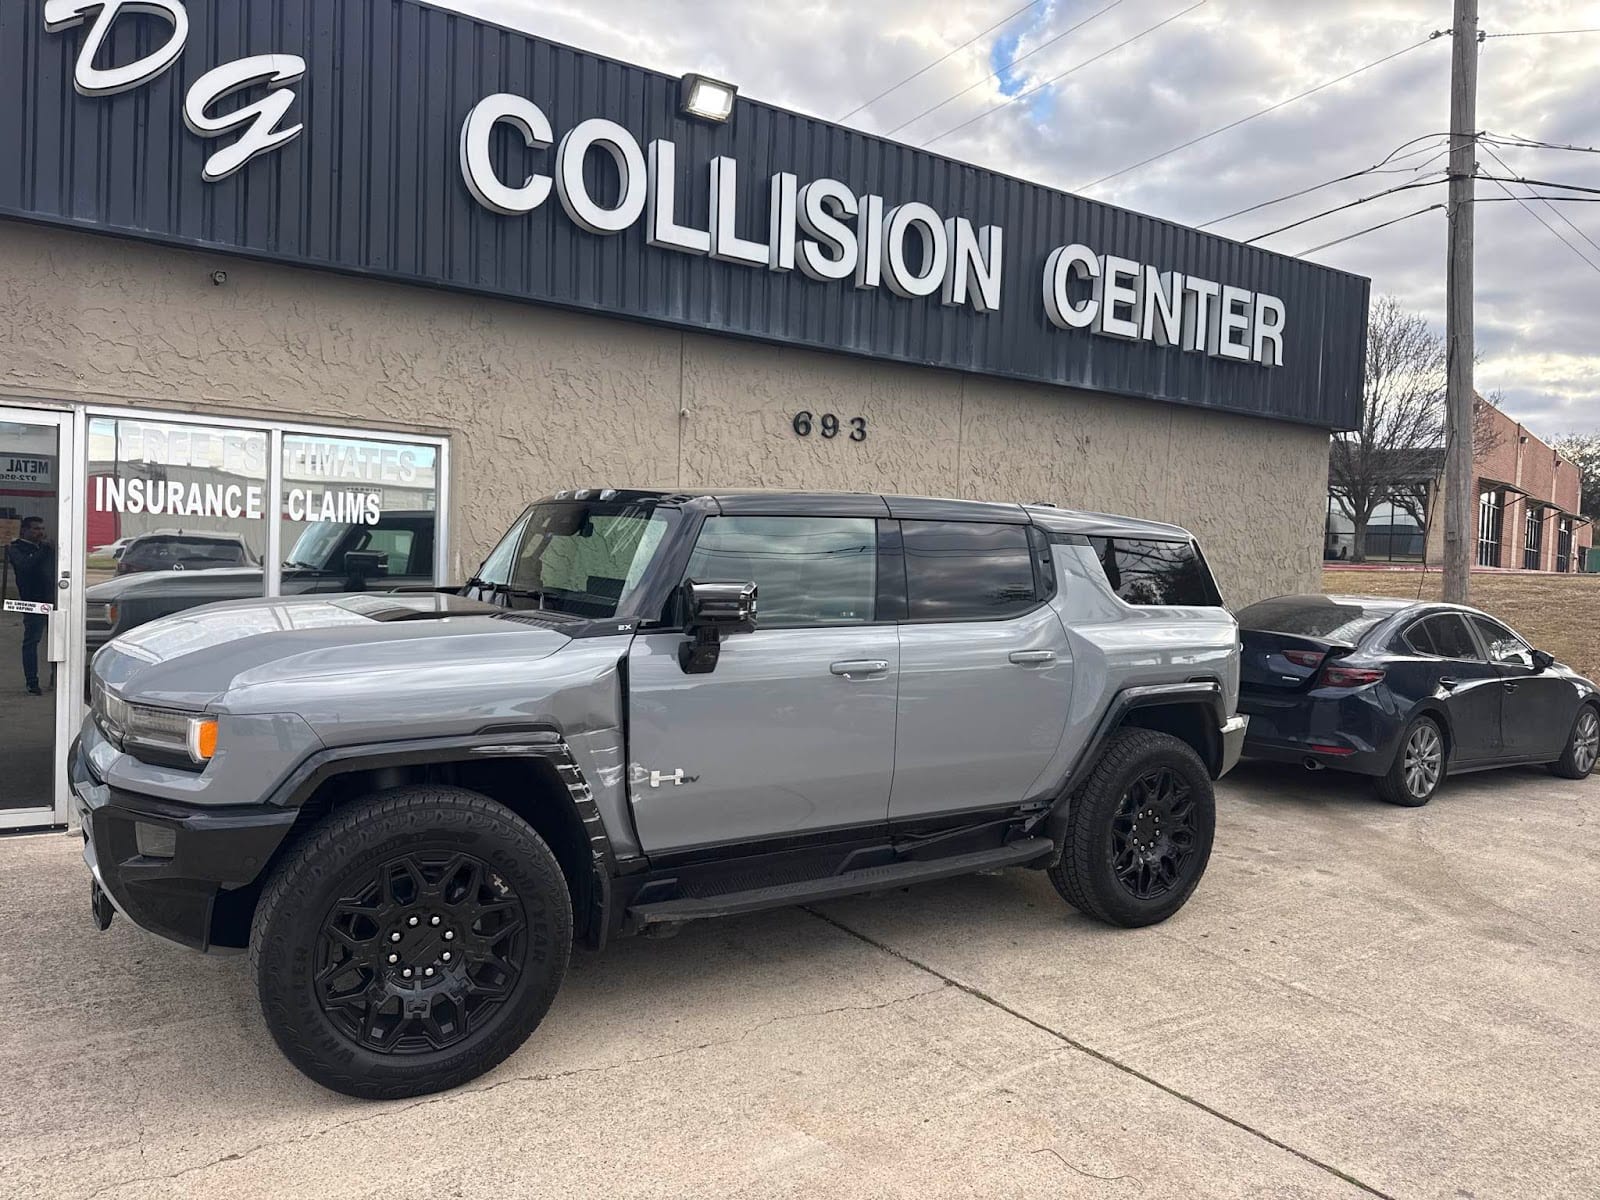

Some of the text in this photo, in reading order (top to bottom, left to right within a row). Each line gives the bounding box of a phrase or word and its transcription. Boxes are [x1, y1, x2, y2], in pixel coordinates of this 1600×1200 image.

[459, 92, 1003, 313] COLLISION
[1042, 243, 1287, 368] CENTER
[120, 426, 211, 468] FREE
[792, 410, 867, 442] 693
[95, 476, 381, 526] INSURANCE CLAIMS
